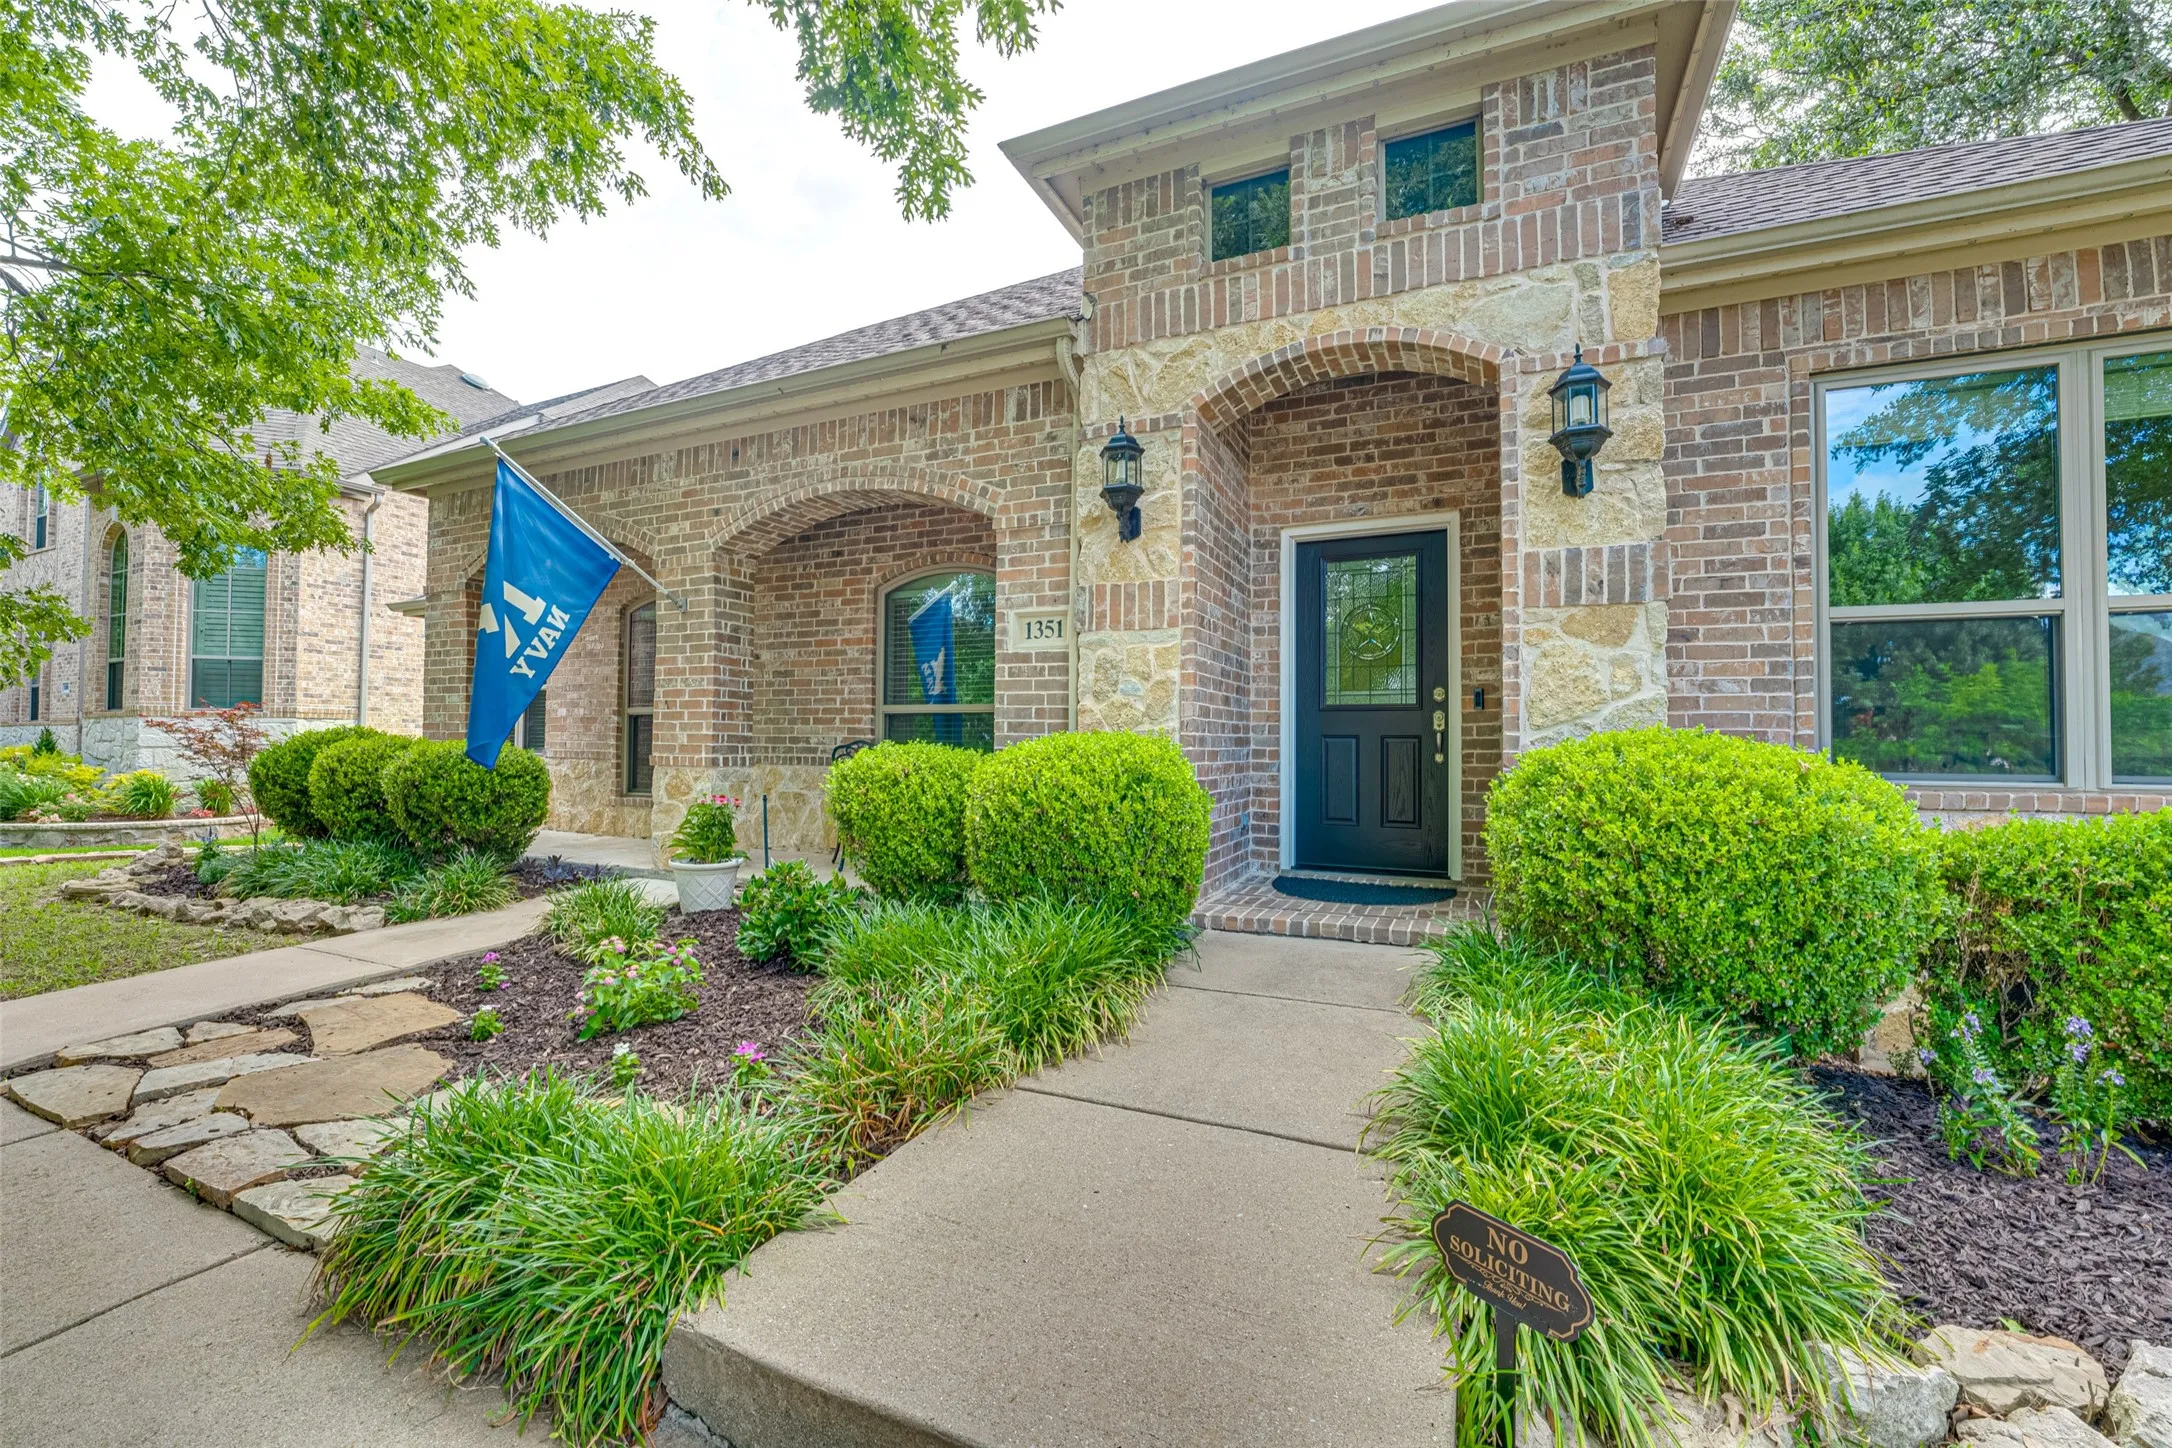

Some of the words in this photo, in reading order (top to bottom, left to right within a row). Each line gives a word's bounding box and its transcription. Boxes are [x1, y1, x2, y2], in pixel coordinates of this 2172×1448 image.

[1025, 619, 1063, 640] 1351
[1486, 1225, 1529, 1266] NO
[1449, 1234, 1570, 1313] SOLICITING
[1482, 1280, 1505, 1298] Thank
